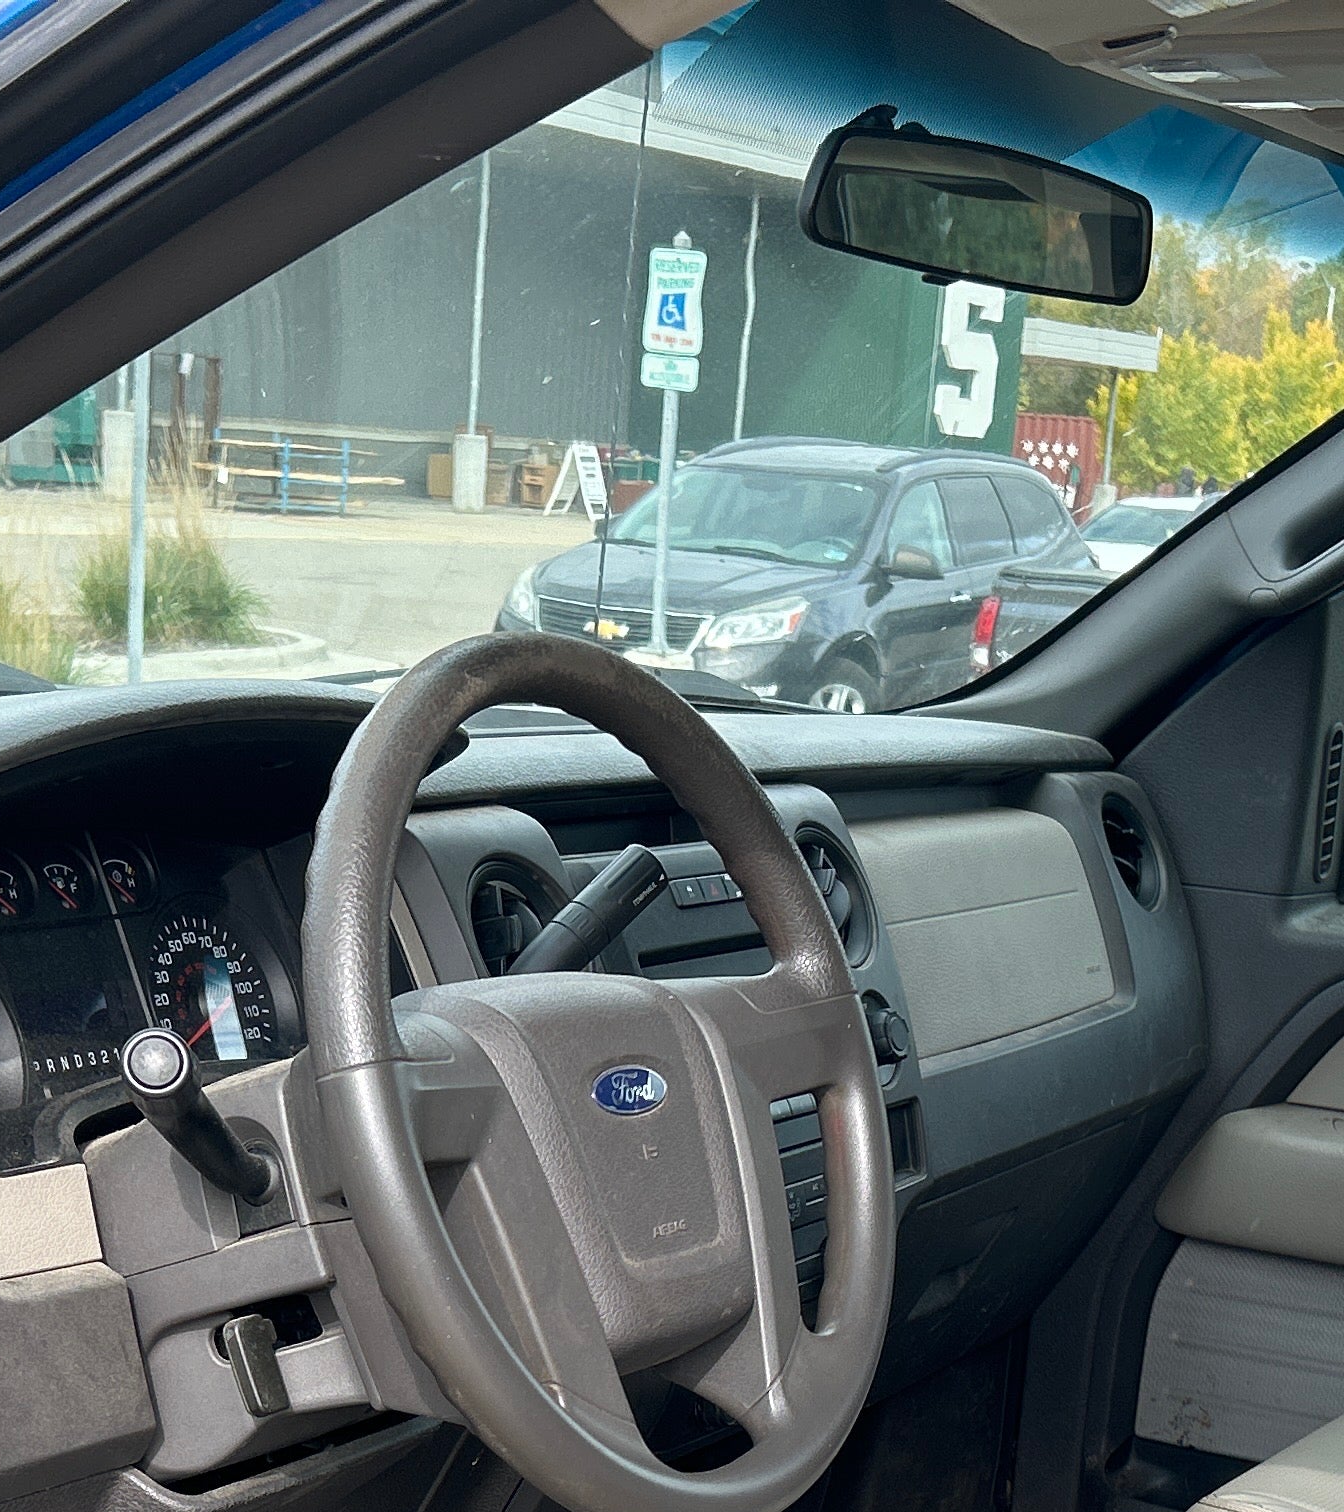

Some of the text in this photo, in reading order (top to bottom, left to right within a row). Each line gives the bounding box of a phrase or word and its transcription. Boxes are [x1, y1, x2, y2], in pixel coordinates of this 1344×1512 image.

[933, 280, 1006, 439] S
[70, 882, 78, 893] F
[127, 878, 136, 888] H
[8, 888, 18, 899] H
[181, 931, 197, 945] 60
[197, 935, 213, 949] 70
[167, 939, 183, 953] 50
[212, 945, 228, 959] 80
[157, 952, 173, 966] 40
[226, 960, 242, 974] 90
[154, 970, 170, 984] 30
[234, 981, 253, 995] 100
[153, 993, 170, 1007] 20
[243, 1004, 260, 1018] 110
[243, 1026, 261, 1040] 120
[46, 1058, 56, 1073] R
[59, 1056, 70, 1071] N
[73, 1054, 83, 1069] D
[87, 1051, 97, 1066] 3
[100, 1049, 110, 1064] 2
[113, 1047, 121, 1061] 1
[611, 1071, 655, 1105] Ford
